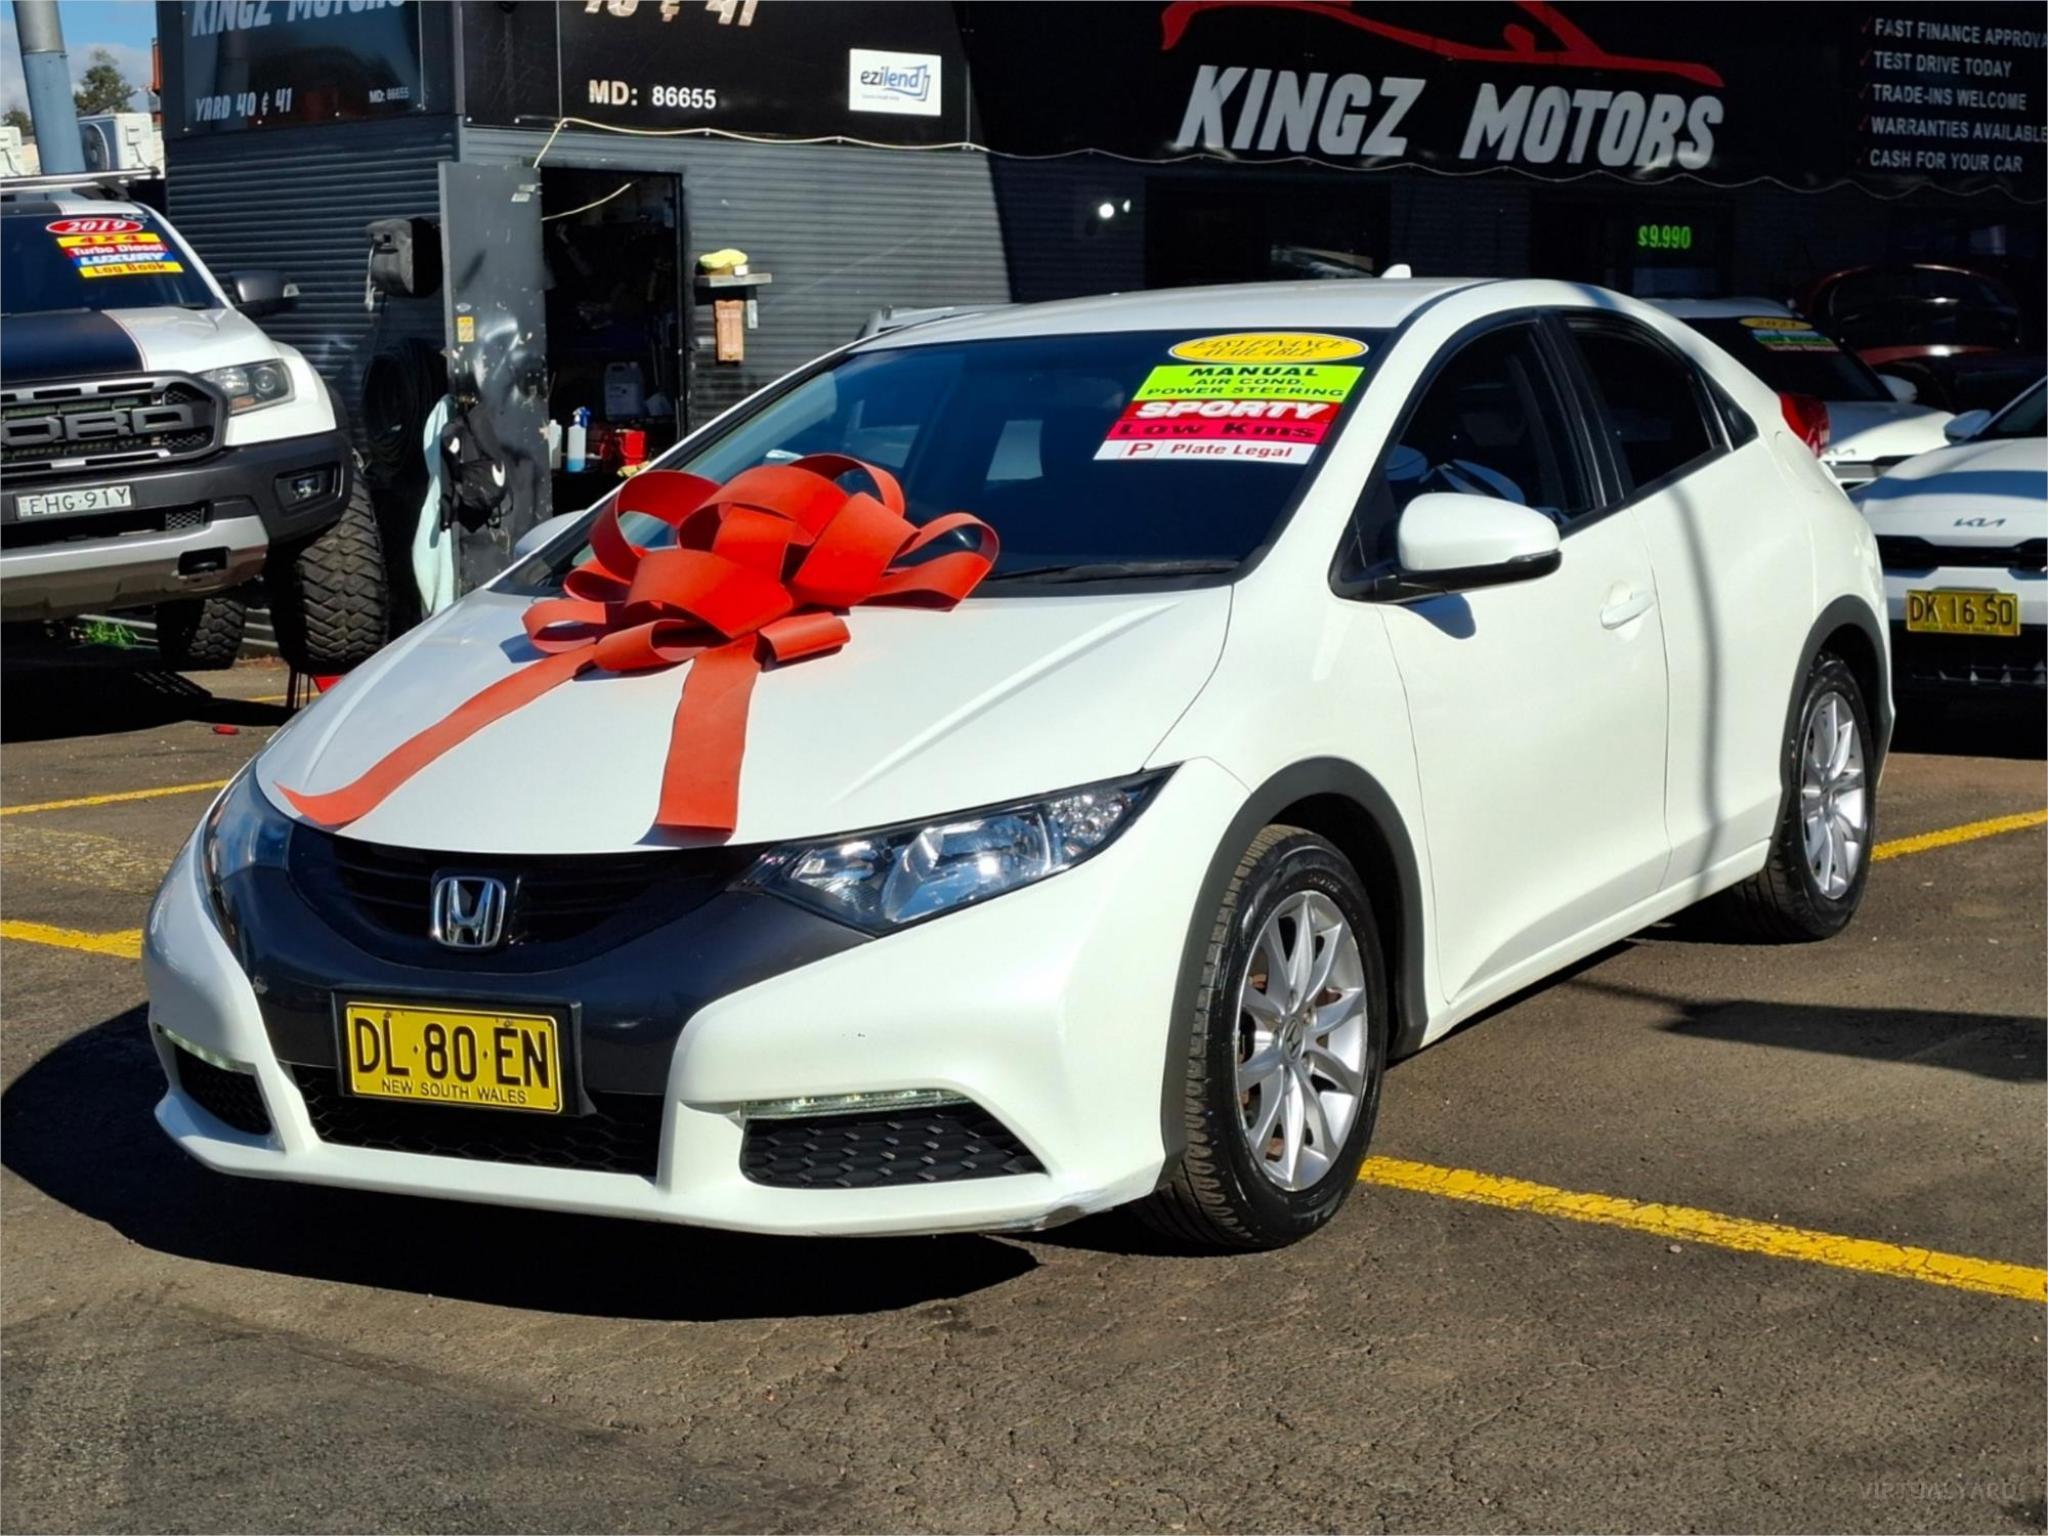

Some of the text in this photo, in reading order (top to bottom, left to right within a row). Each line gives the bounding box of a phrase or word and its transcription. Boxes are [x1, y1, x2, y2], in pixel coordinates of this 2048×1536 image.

[1874, 18, 1913, 39] FAST
[1917, 22, 1981, 44] FINANCE
[1873, 51, 2012, 77] TEST DRIVE TODAY
[860, 66, 922, 88] ezilend
[589, 79, 717, 110] MD: 86655
[1872, 83, 2027, 111] TRADE-INS WELCOME
[195, 96, 231, 122] YARD
[236, 92, 256, 117] 40
[275, 88, 292, 112] 41
[1176, 64, 1724, 170] KINGZ MOTORS
[1871, 116, 2047, 143] WARRANTIES AVAILABLE
[1870, 149, 2023, 172] CASH FOR YOUR CAR
[65, 221, 127, 232] 2019
[70, 244, 164, 256] Turbo Diesel
[81, 252, 166, 266] LUXURY
[93, 262, 168, 275] Log Book
[1189, 367, 1319, 377] MANUAL
[1240, 378, 1304, 386] COND.
[1147, 387, 1344, 397] POWER STEERING
[1136, 401, 1329, 419] SPORTY
[1119, 422, 1316, 438] Low Kms
[1128, 443, 1292, 458] P Plate Legal
[382, 1079, 527, 1104] NEW SOUTH WALES
